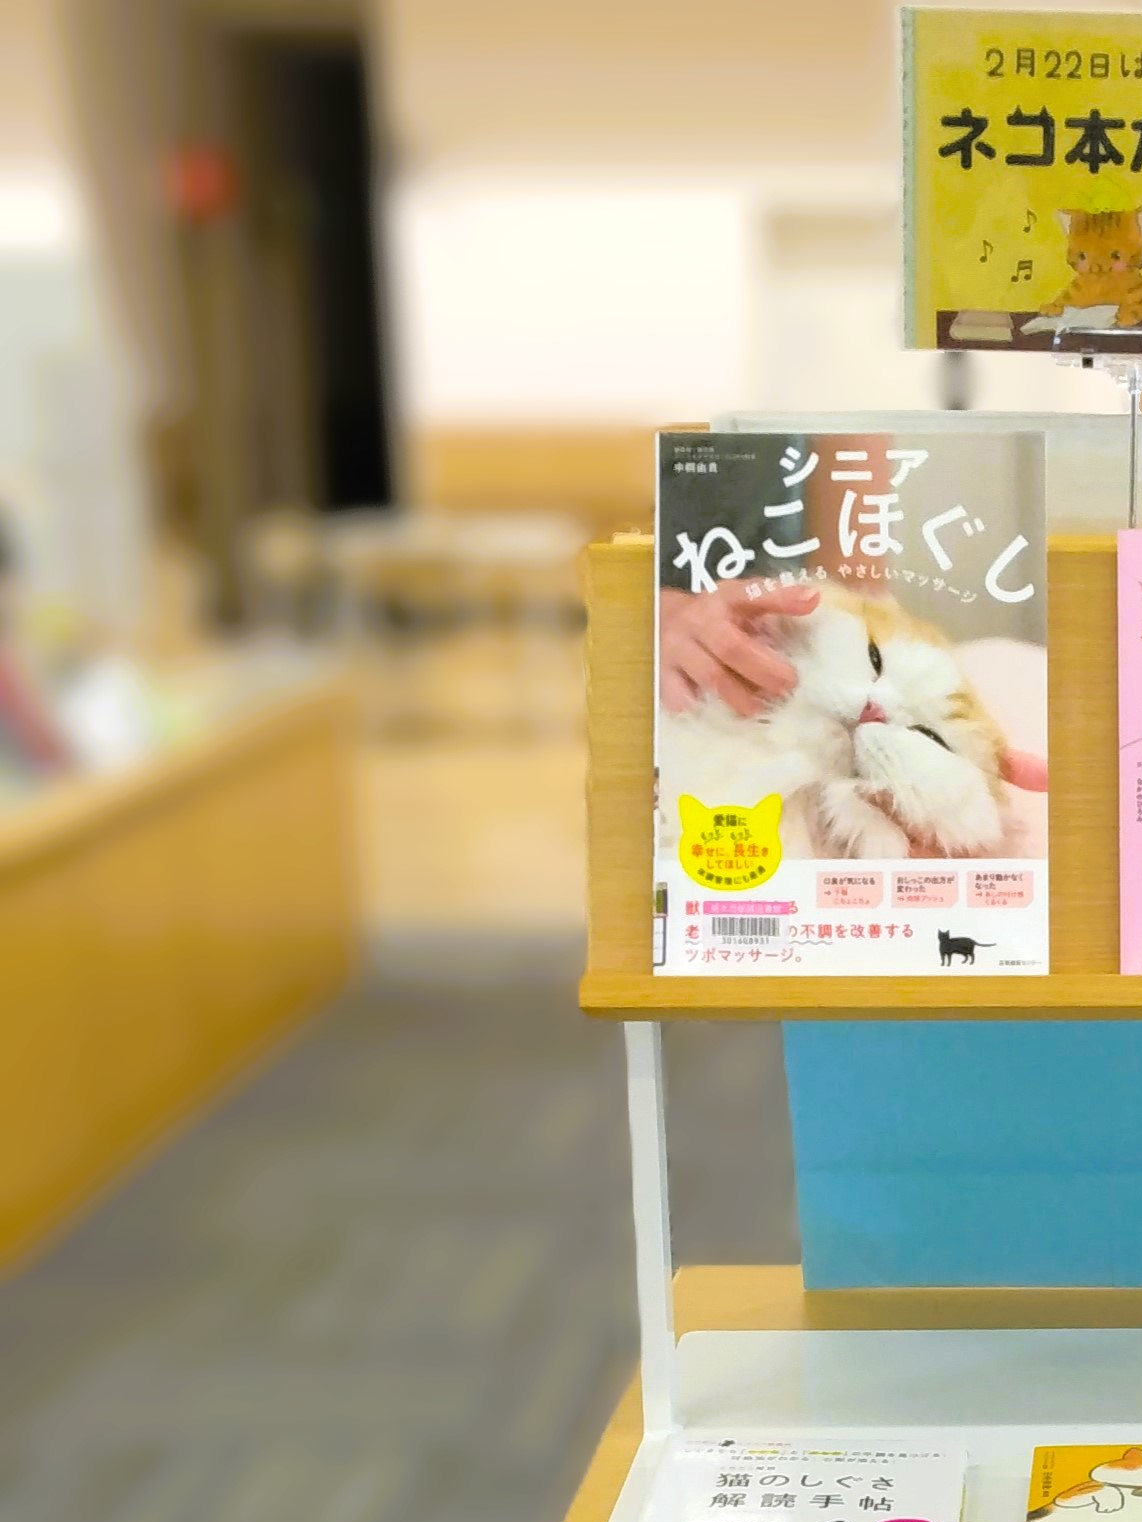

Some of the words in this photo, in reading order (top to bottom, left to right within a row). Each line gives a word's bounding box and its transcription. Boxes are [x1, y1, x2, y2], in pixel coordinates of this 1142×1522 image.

[779, 446, 929, 487] シニア
[673, 489, 1034, 603] ねこほぐし
[715, 1472, 895, 1491] 猫のしぐさ
[709, 1492, 895, 1512] 解読手帖
